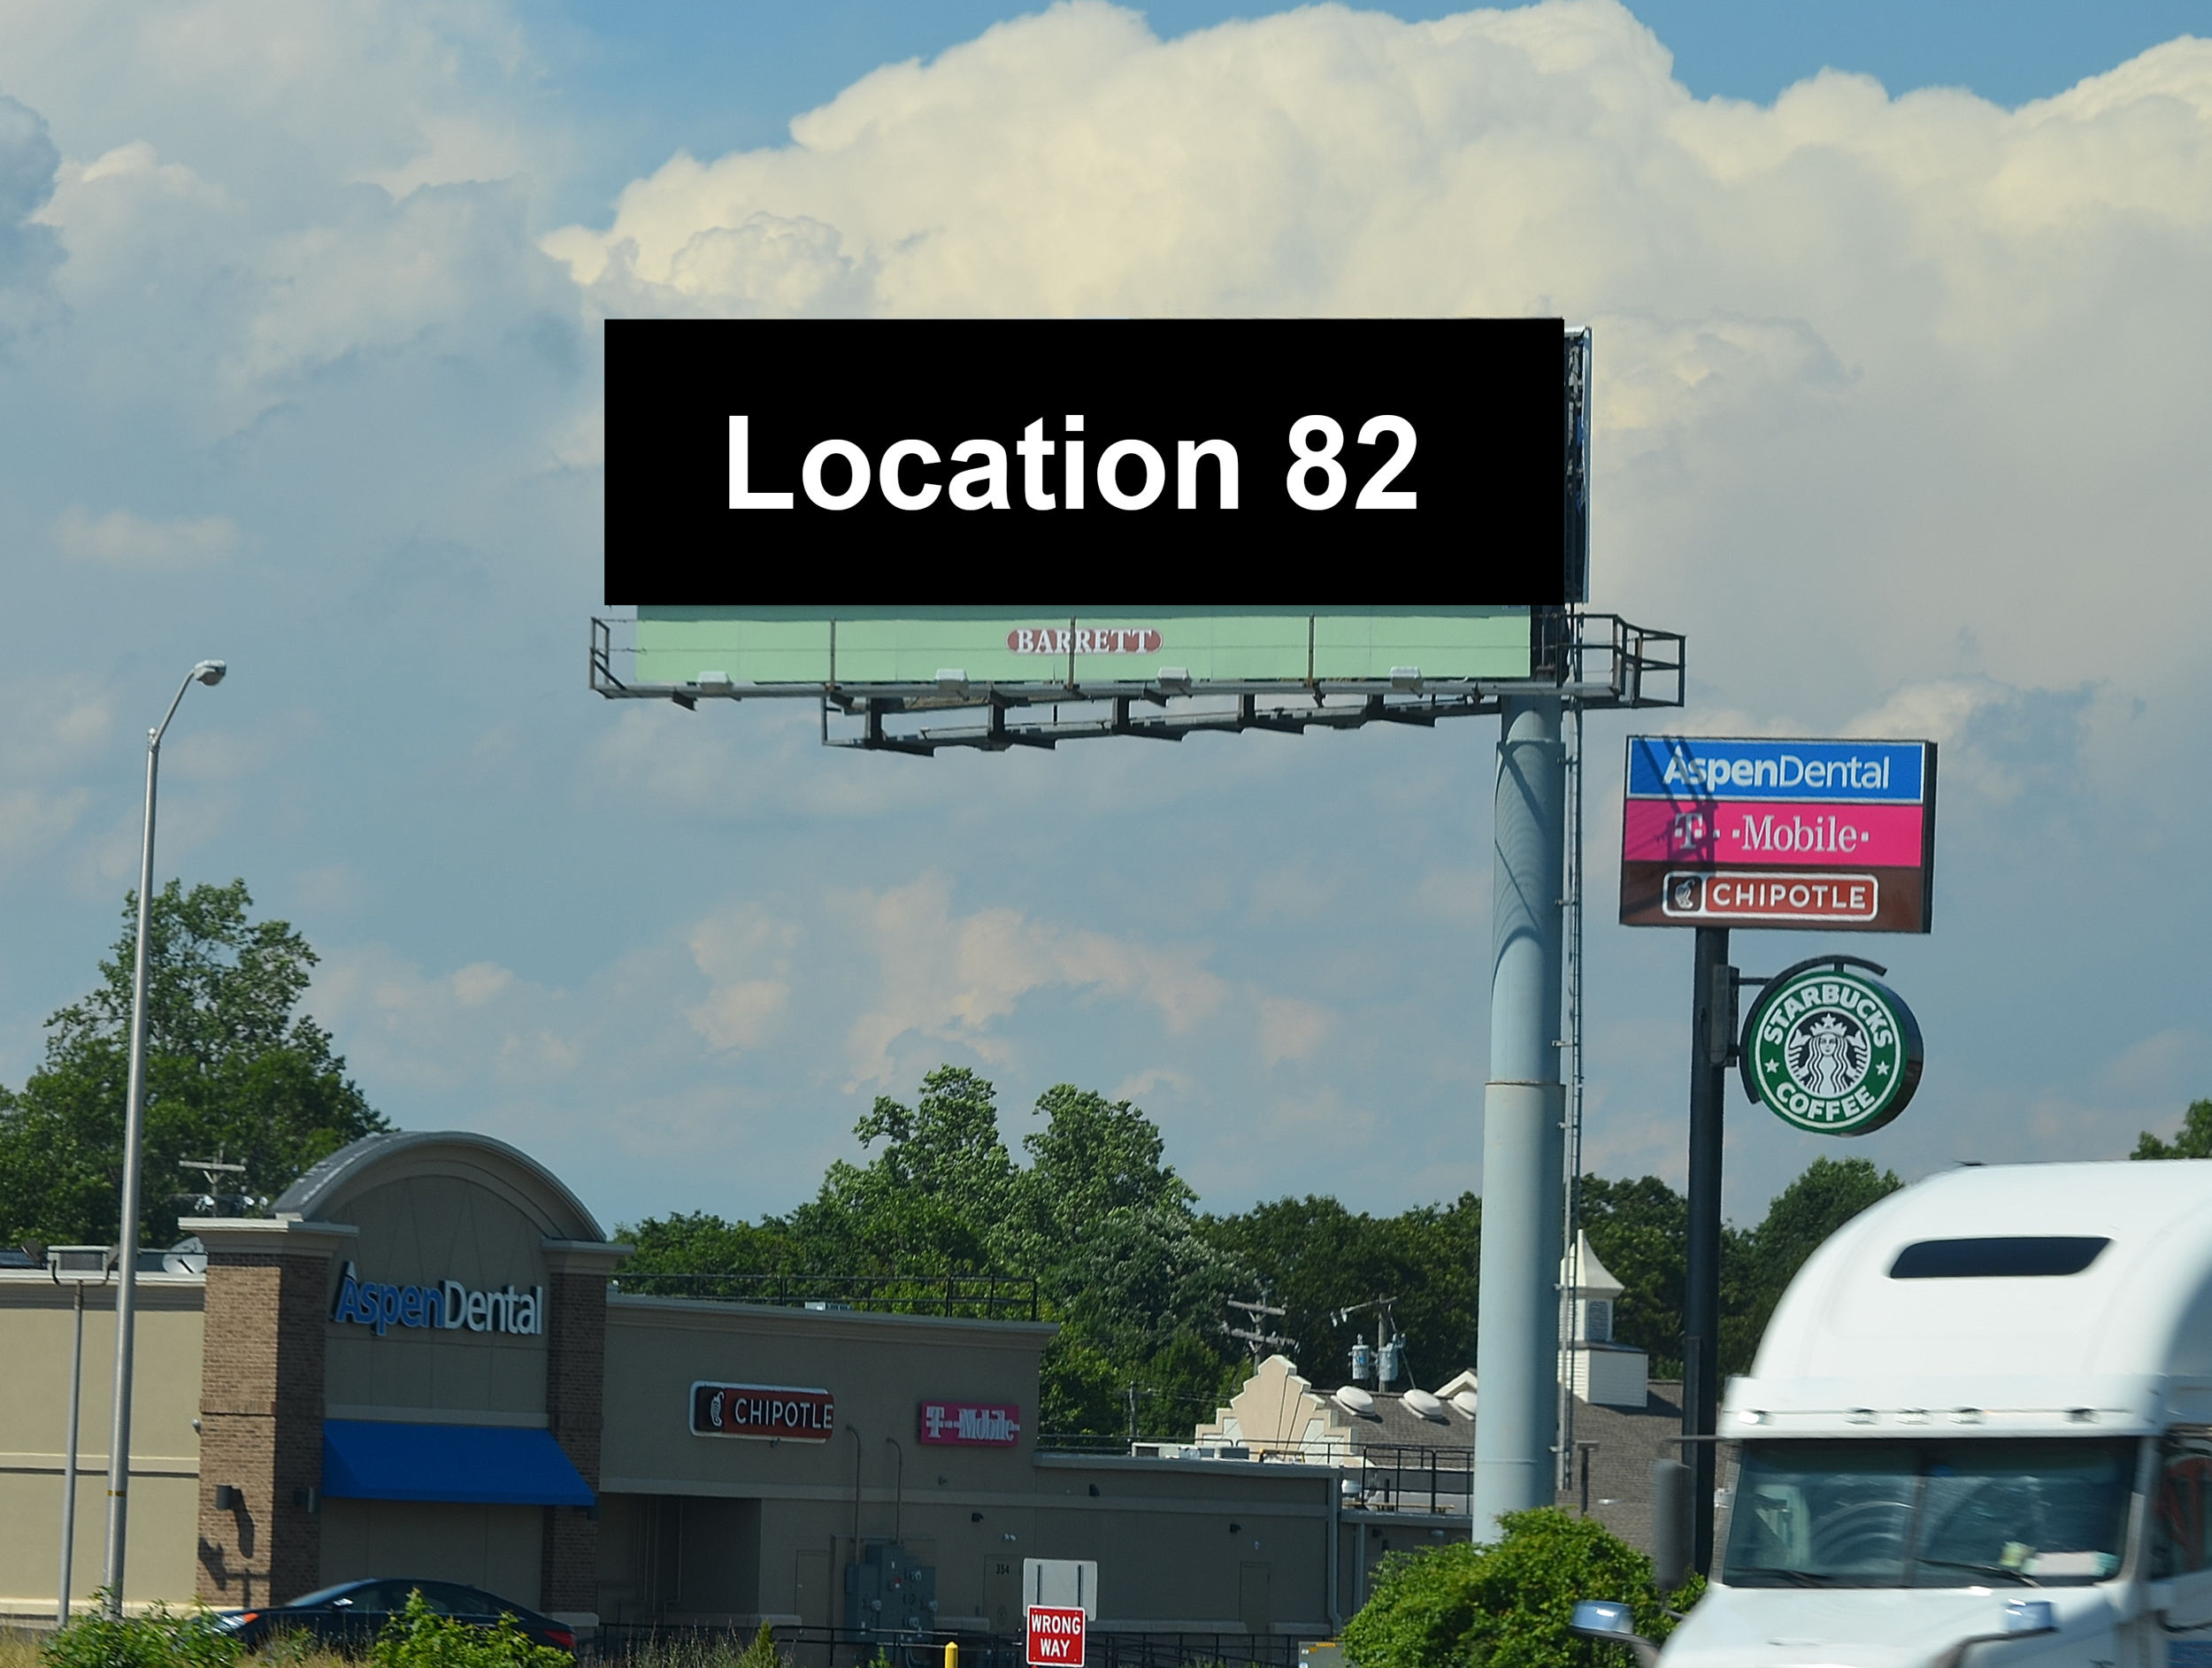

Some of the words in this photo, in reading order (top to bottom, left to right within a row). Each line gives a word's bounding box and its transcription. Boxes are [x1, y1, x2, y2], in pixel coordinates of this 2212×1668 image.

[1017, 629, 1153, 655] BARRETT
[1712, 882, 1866, 910] CHIPOTLE
[1763, 984, 1893, 1049] STARBUCKS
[1776, 1081, 1876, 1121] COFFEE
[734, 1397, 834, 1429] CHIPOTLE
[1031, 1613, 1081, 1635] WRONG
[1040, 1637, 1071, 1657] WAY
